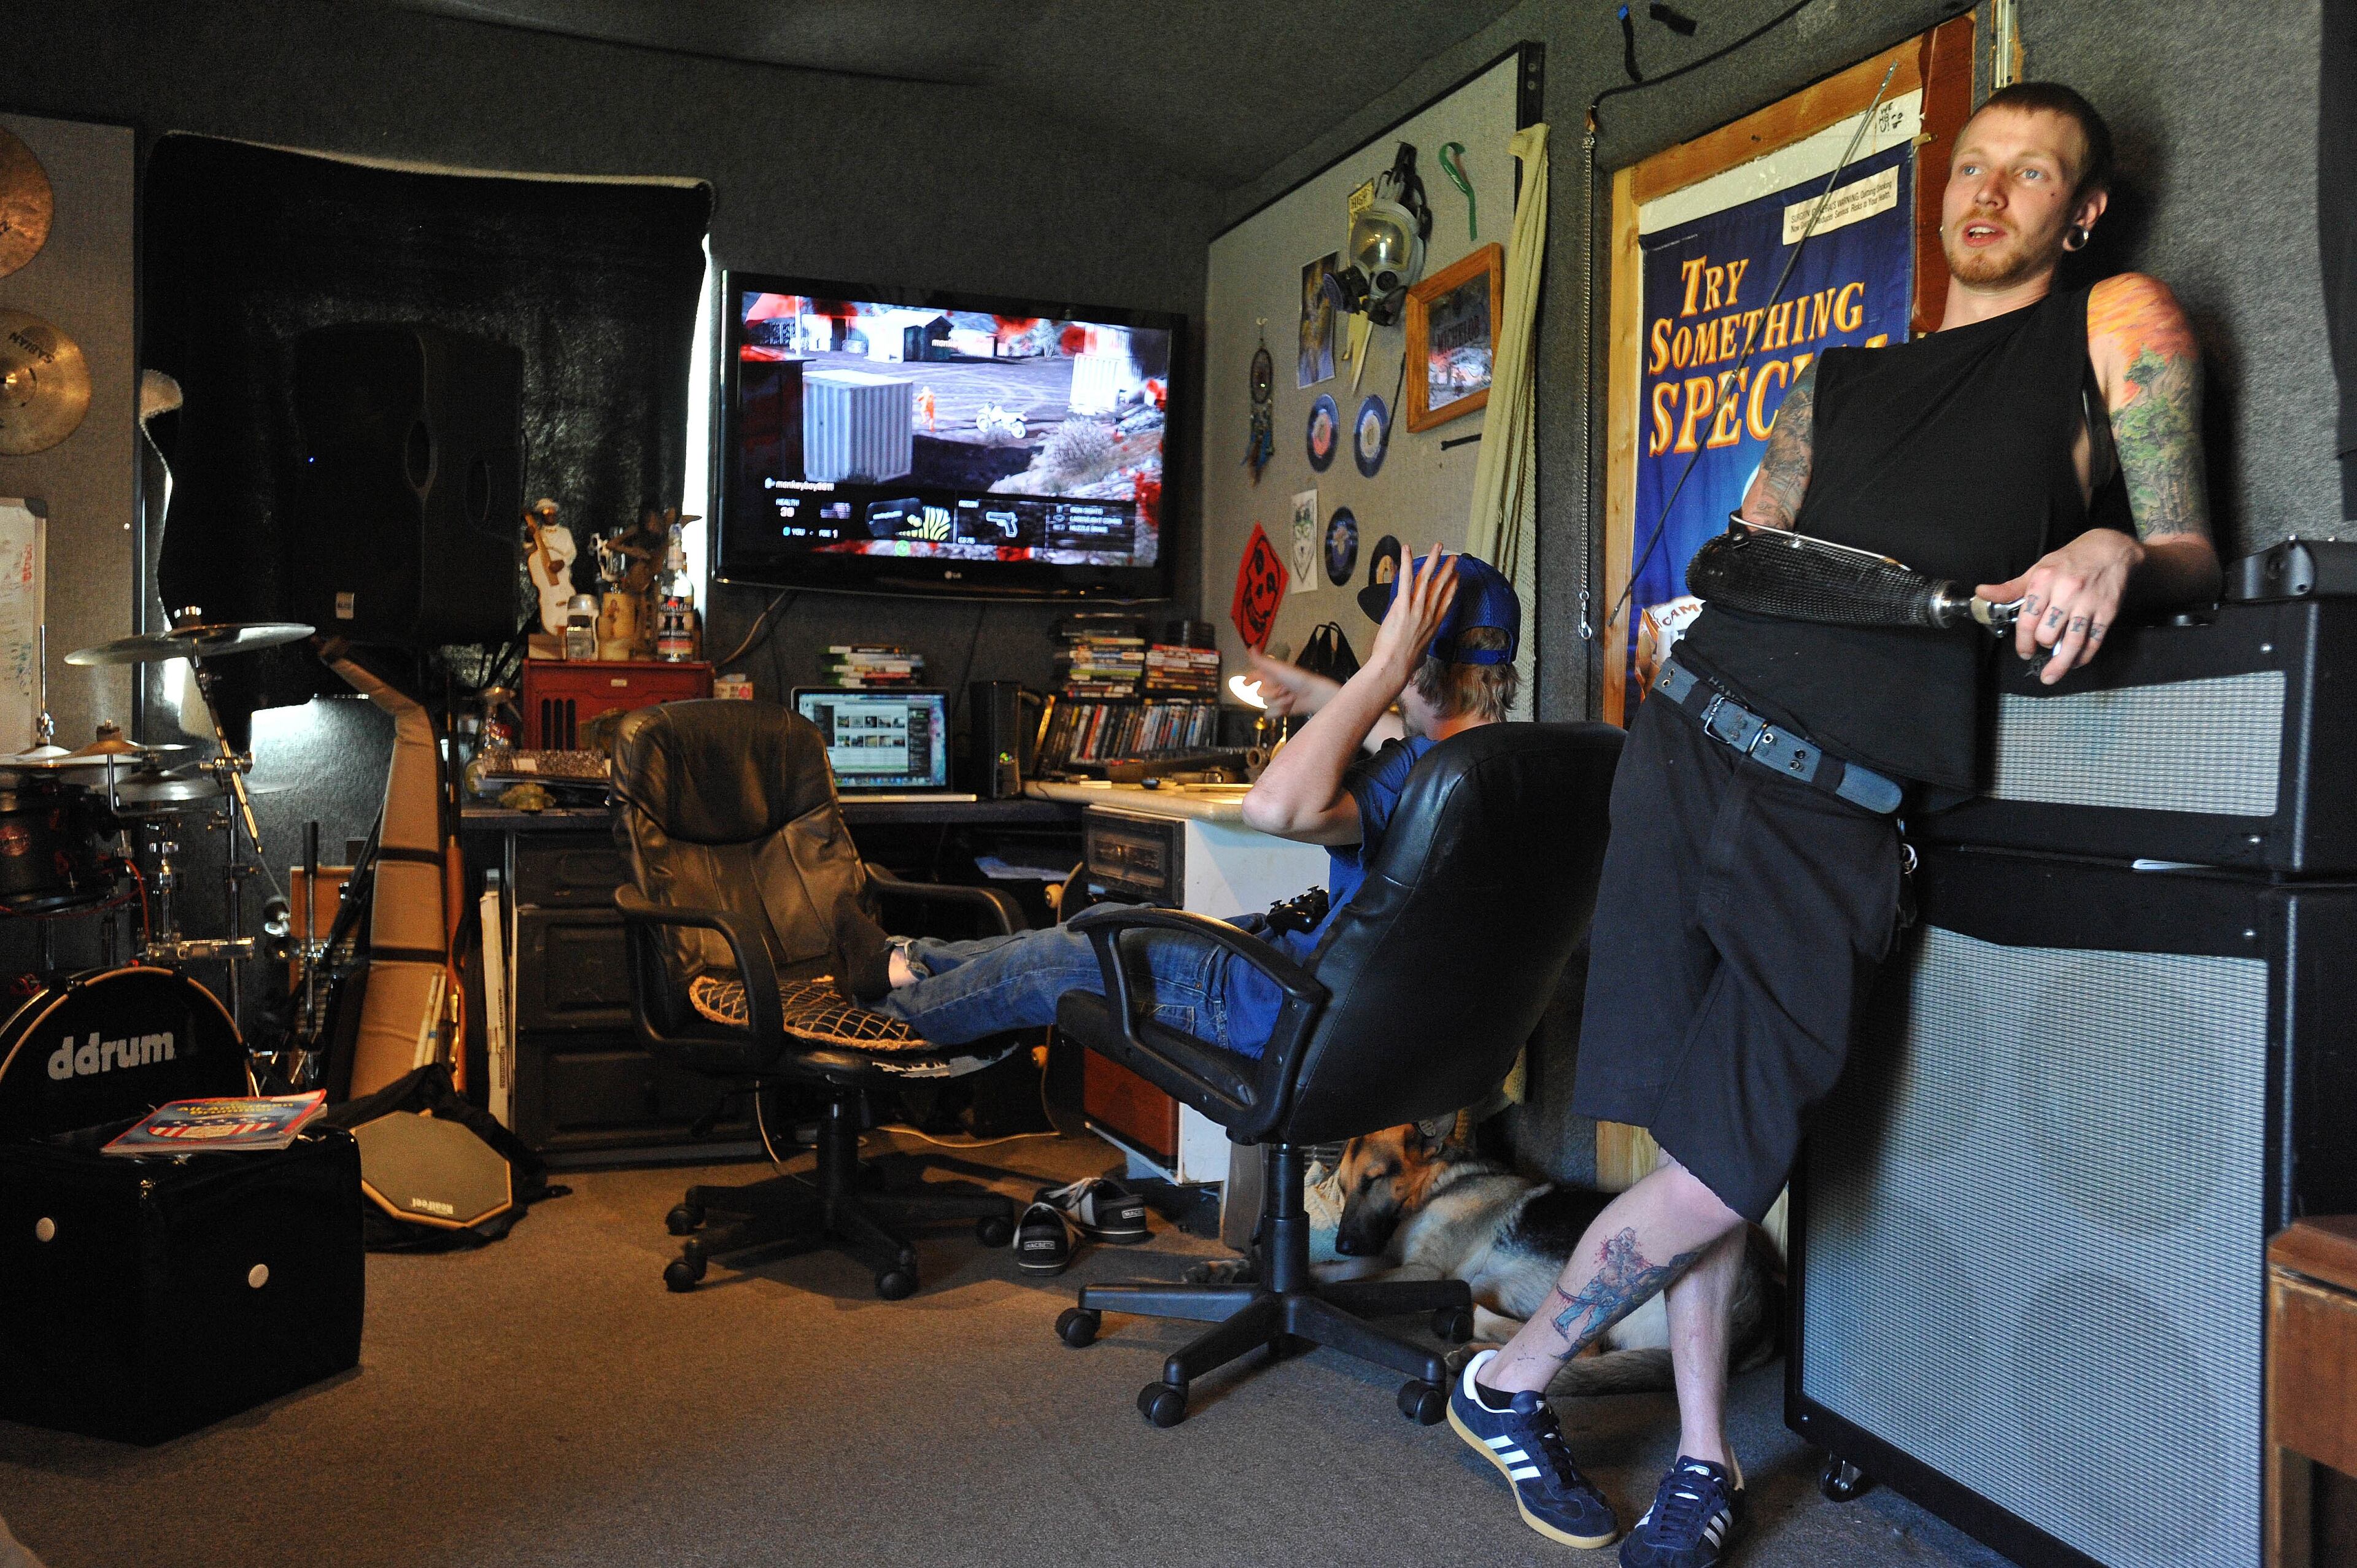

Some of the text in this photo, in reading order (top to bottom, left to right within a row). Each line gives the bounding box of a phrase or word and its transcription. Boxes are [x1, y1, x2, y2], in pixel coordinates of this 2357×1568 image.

[1680, 255, 1749, 319] TRY
[10, 332, 55, 363] SABIAN
[1648, 282, 1865, 376] SOMETHING
[1662, 604, 1701, 626] CAM
[48, 1032, 175, 1081] ddrum
